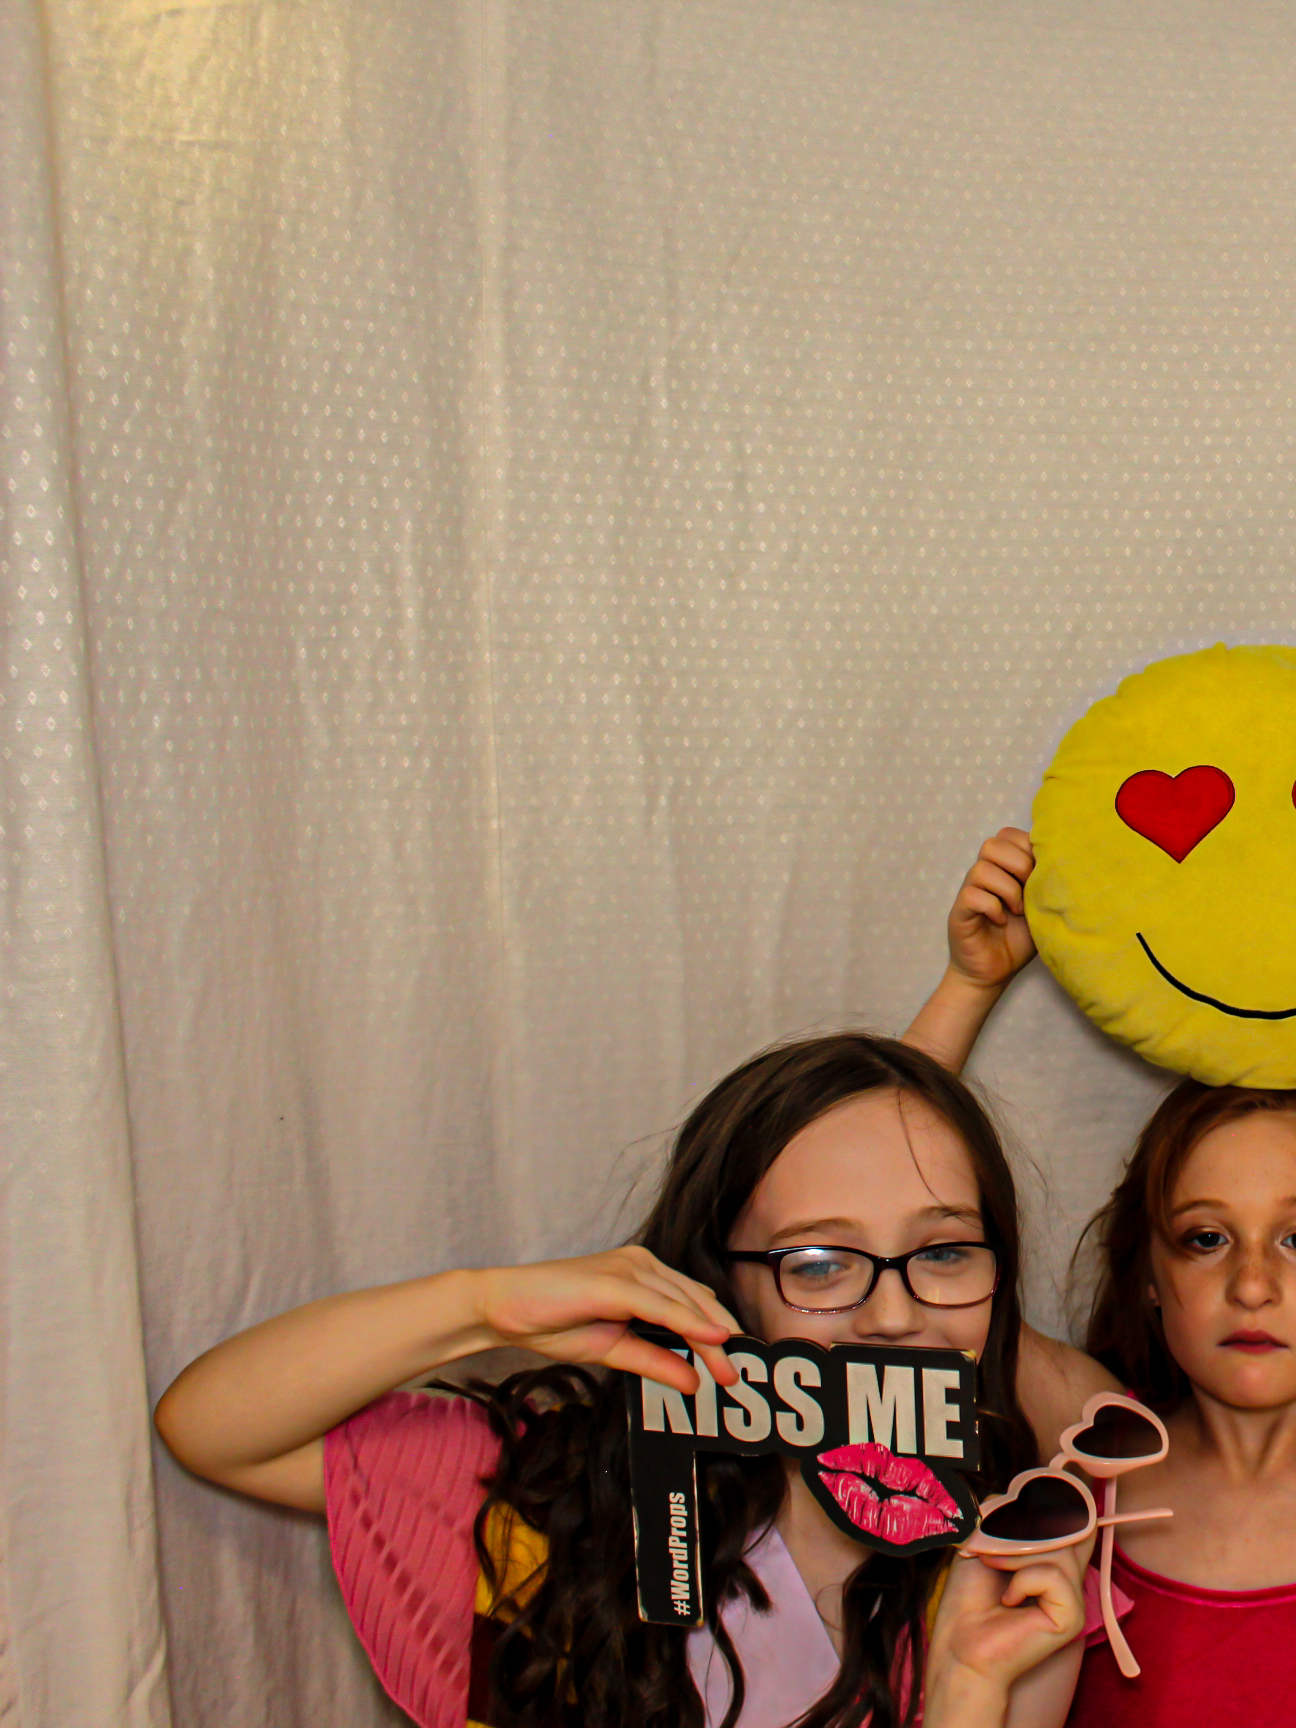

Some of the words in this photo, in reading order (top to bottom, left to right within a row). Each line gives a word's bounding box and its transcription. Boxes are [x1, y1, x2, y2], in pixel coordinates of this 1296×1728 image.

[641, 1348, 825, 1448] KISS
[846, 1361, 964, 1458] ME
[668, 1491, 691, 1616] #WordProps
